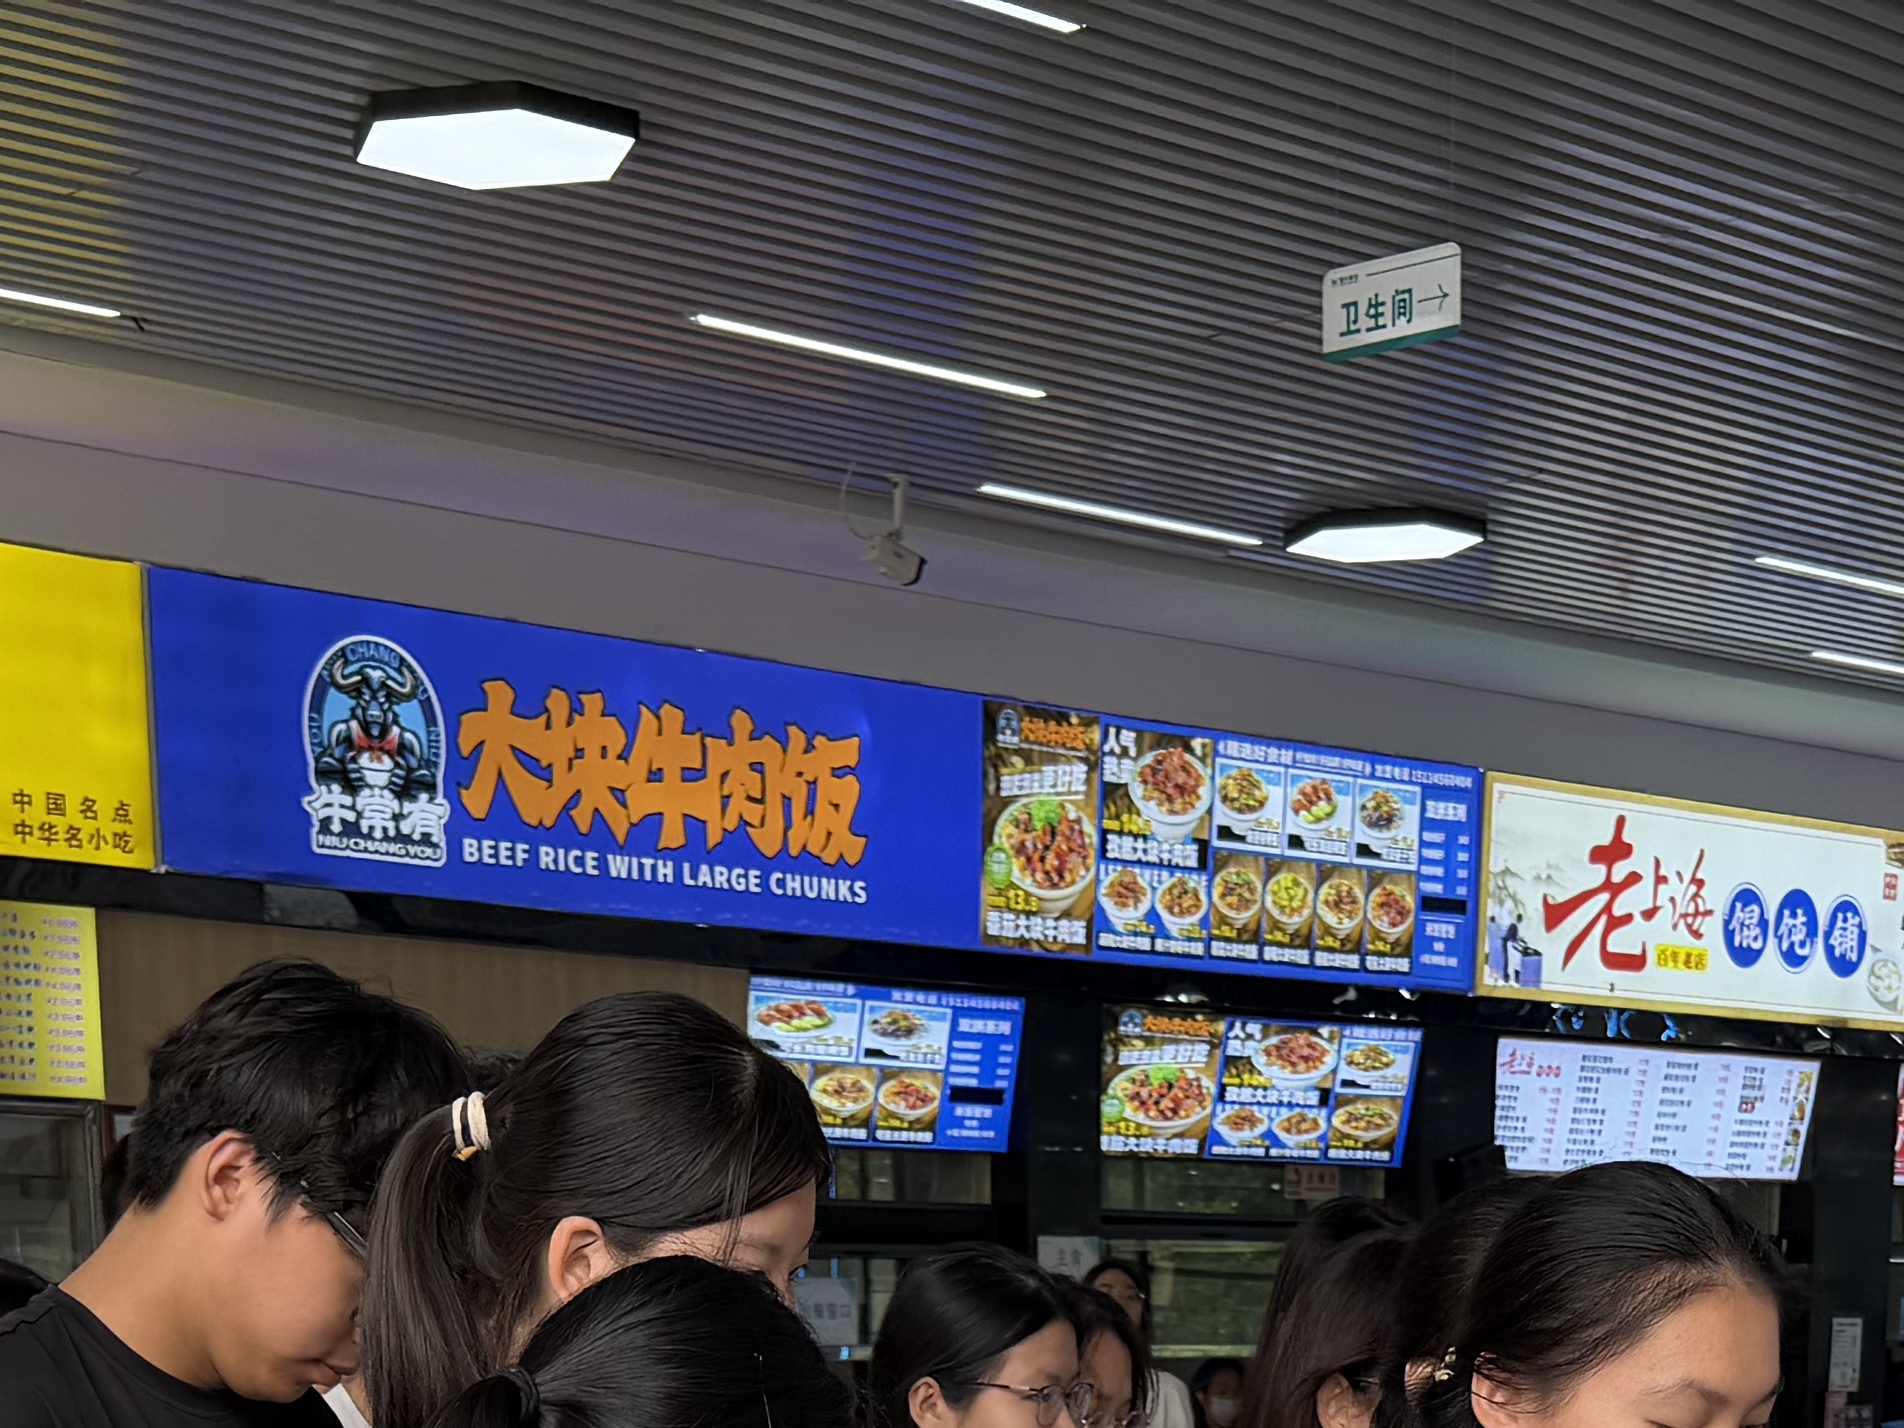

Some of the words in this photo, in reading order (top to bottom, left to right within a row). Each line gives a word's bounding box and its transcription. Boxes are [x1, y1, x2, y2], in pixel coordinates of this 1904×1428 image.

[1339, 288, 1413, 337] 卫生间
[457, 680, 868, 866] 大块牛肉饭
[10, 787, 135, 824] 中国名点
[311, 783, 446, 844] 牛常有
[10, 818, 137, 857] 中华名小吃
[463, 837, 530, 869] BEEF
[538, 844, 601, 879] RICE
[607, 851, 676, 886] WITH
[682, 859, 762, 895] LARGE
[769, 870, 868, 906] CHUNKS
[1543, 814, 1715, 973] 老上海
[1729, 906, 1861, 964] 馄饨铺
